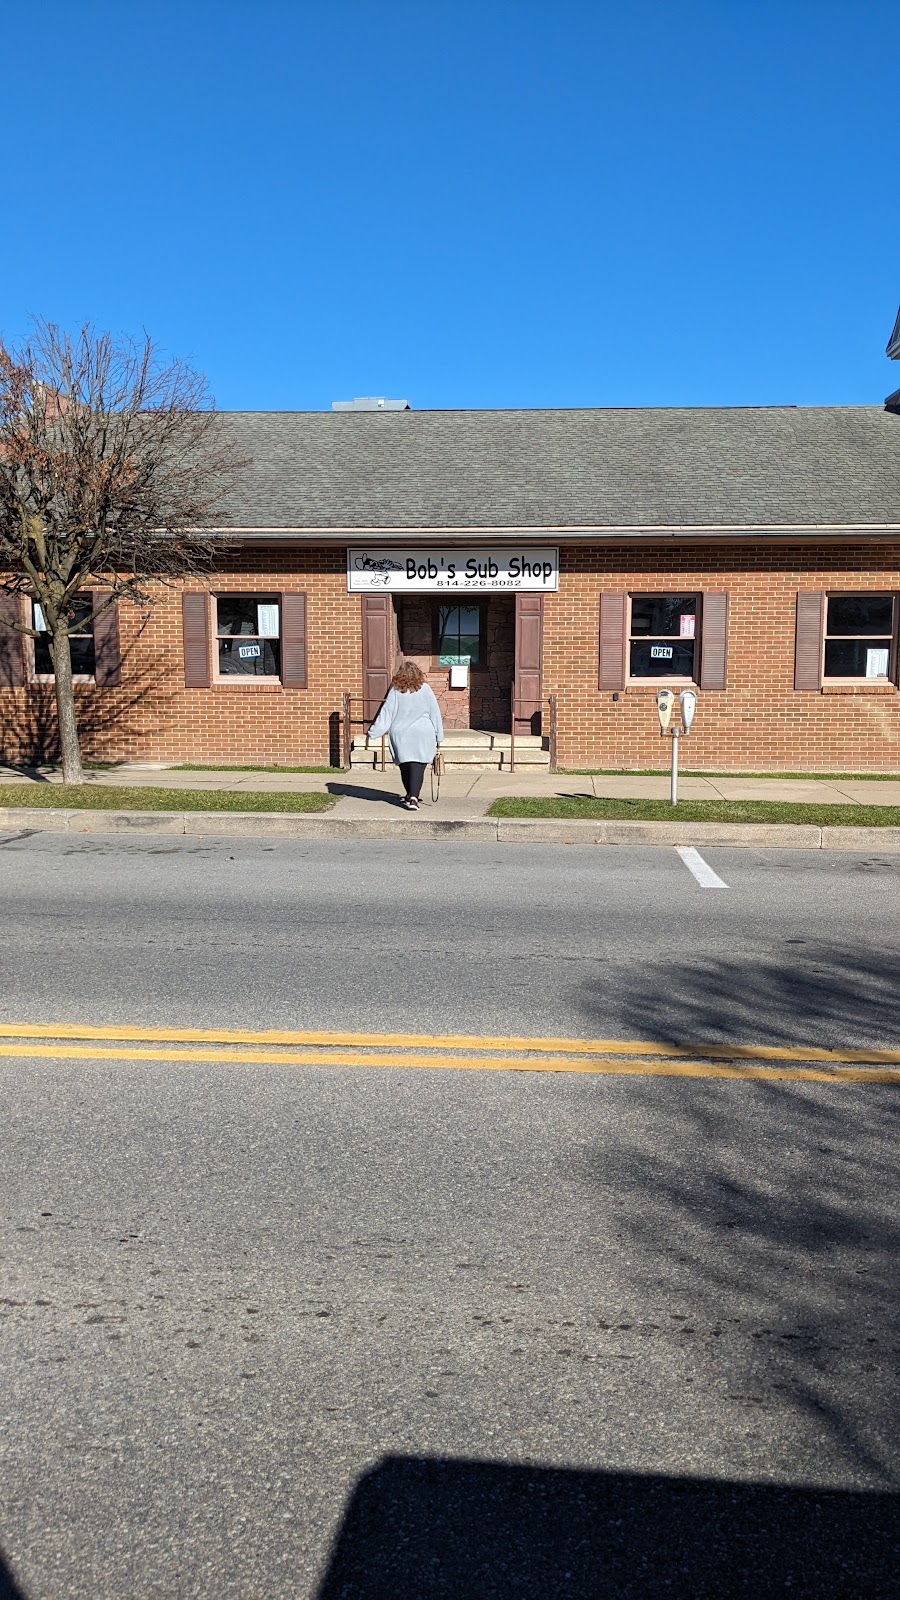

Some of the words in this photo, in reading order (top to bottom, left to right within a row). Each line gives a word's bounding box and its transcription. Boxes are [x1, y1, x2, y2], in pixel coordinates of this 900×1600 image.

[406, 557, 455, 579] Bob's
[465, 556, 498, 579] Sub
[508, 555, 552, 584] Shop
[241, 647, 259, 656] OPEN
[653, 648, 671, 657] OPEN
